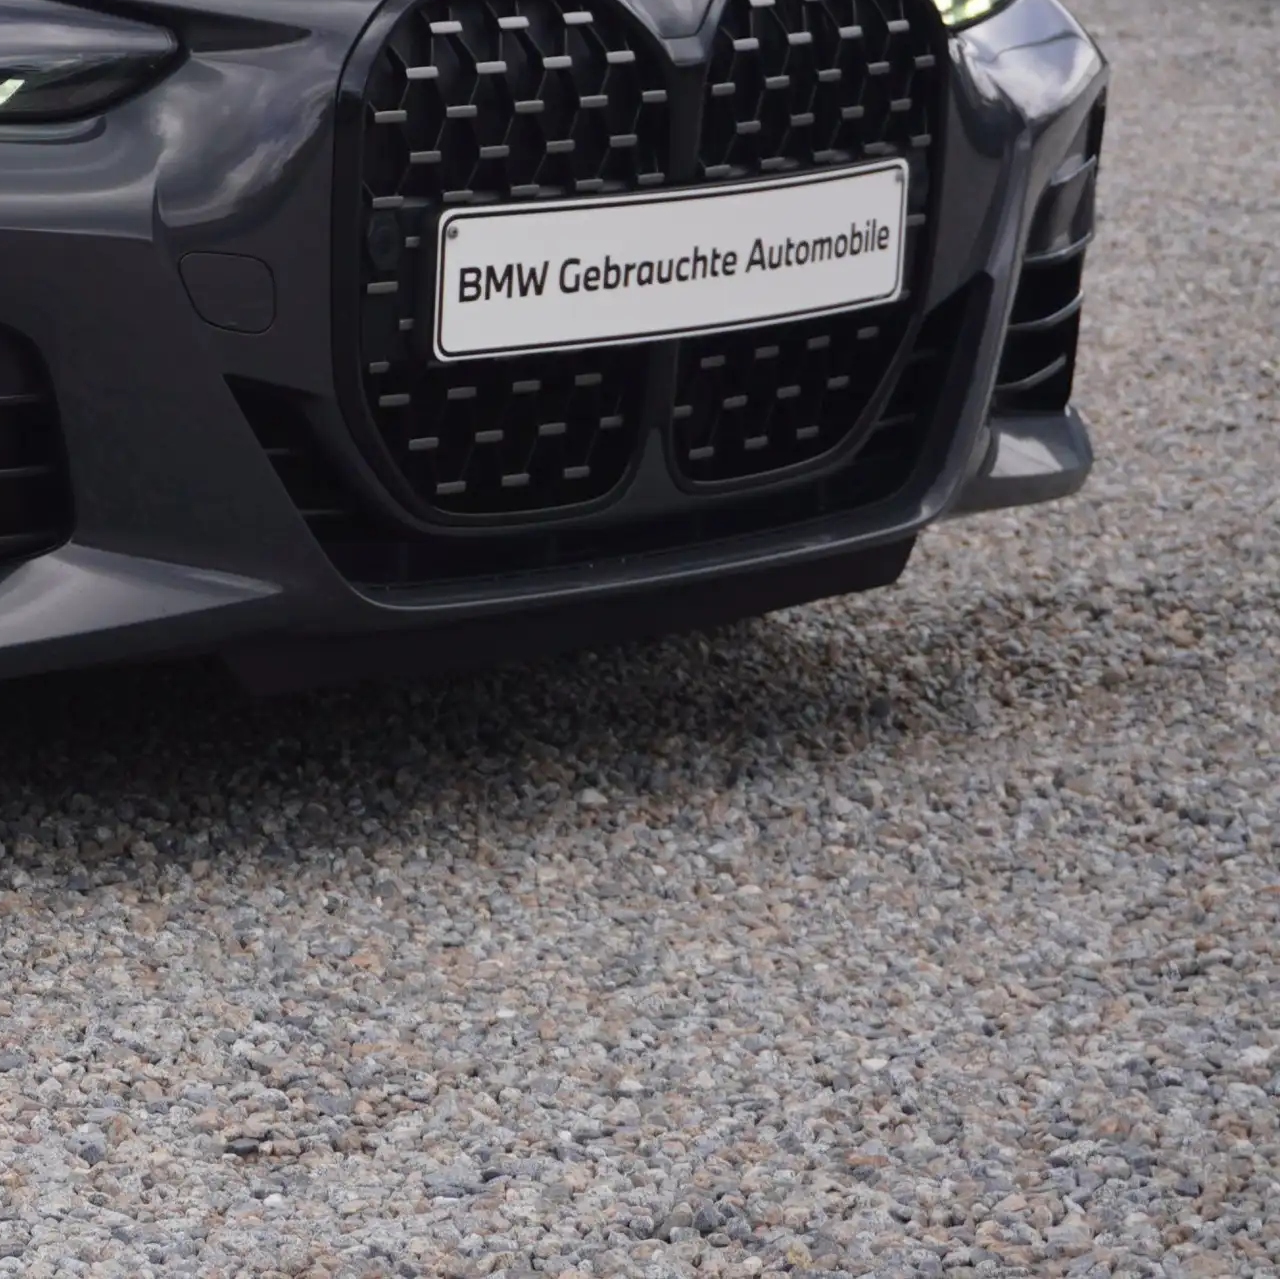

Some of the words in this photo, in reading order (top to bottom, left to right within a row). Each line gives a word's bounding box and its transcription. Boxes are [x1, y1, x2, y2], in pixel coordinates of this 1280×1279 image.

[458, 260, 550, 303] BMW
[558, 245, 738, 294] Gebrauchte
[745, 218, 891, 273] Automobile
